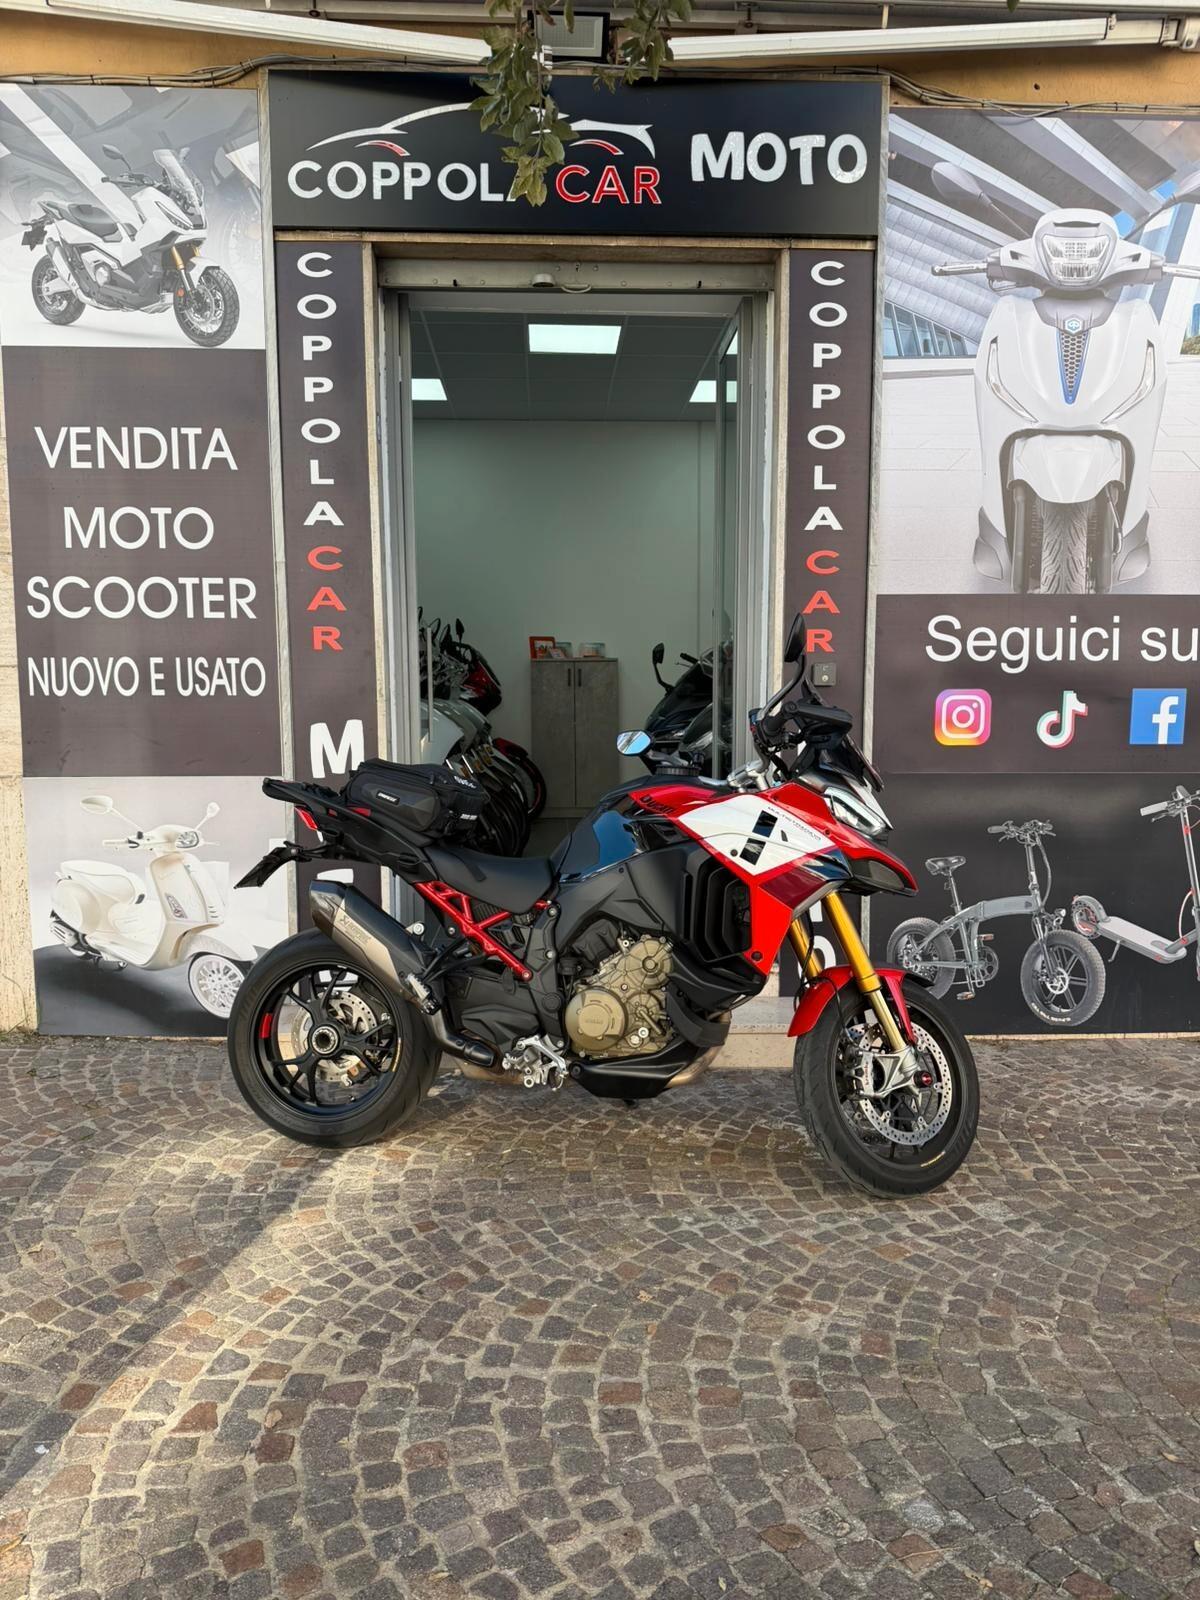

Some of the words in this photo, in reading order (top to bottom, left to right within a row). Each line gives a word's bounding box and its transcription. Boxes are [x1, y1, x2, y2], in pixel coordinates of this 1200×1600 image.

[690, 131, 868, 185] MOTO
[287, 160, 524, 201] COPPOL
[555, 164, 662, 204] CAR
[33, 426, 239, 471] VENDITA
[63, 505, 215, 550] MOTO
[26, 575, 257, 620] SCOOTER
[925, 614, 1121, 674] Seguici
[1140, 626, 1199, 662] su
[27, 655, 140, 697] NUOVO
[149, 656, 166, 696] E
[175, 656, 266, 697] USATO
